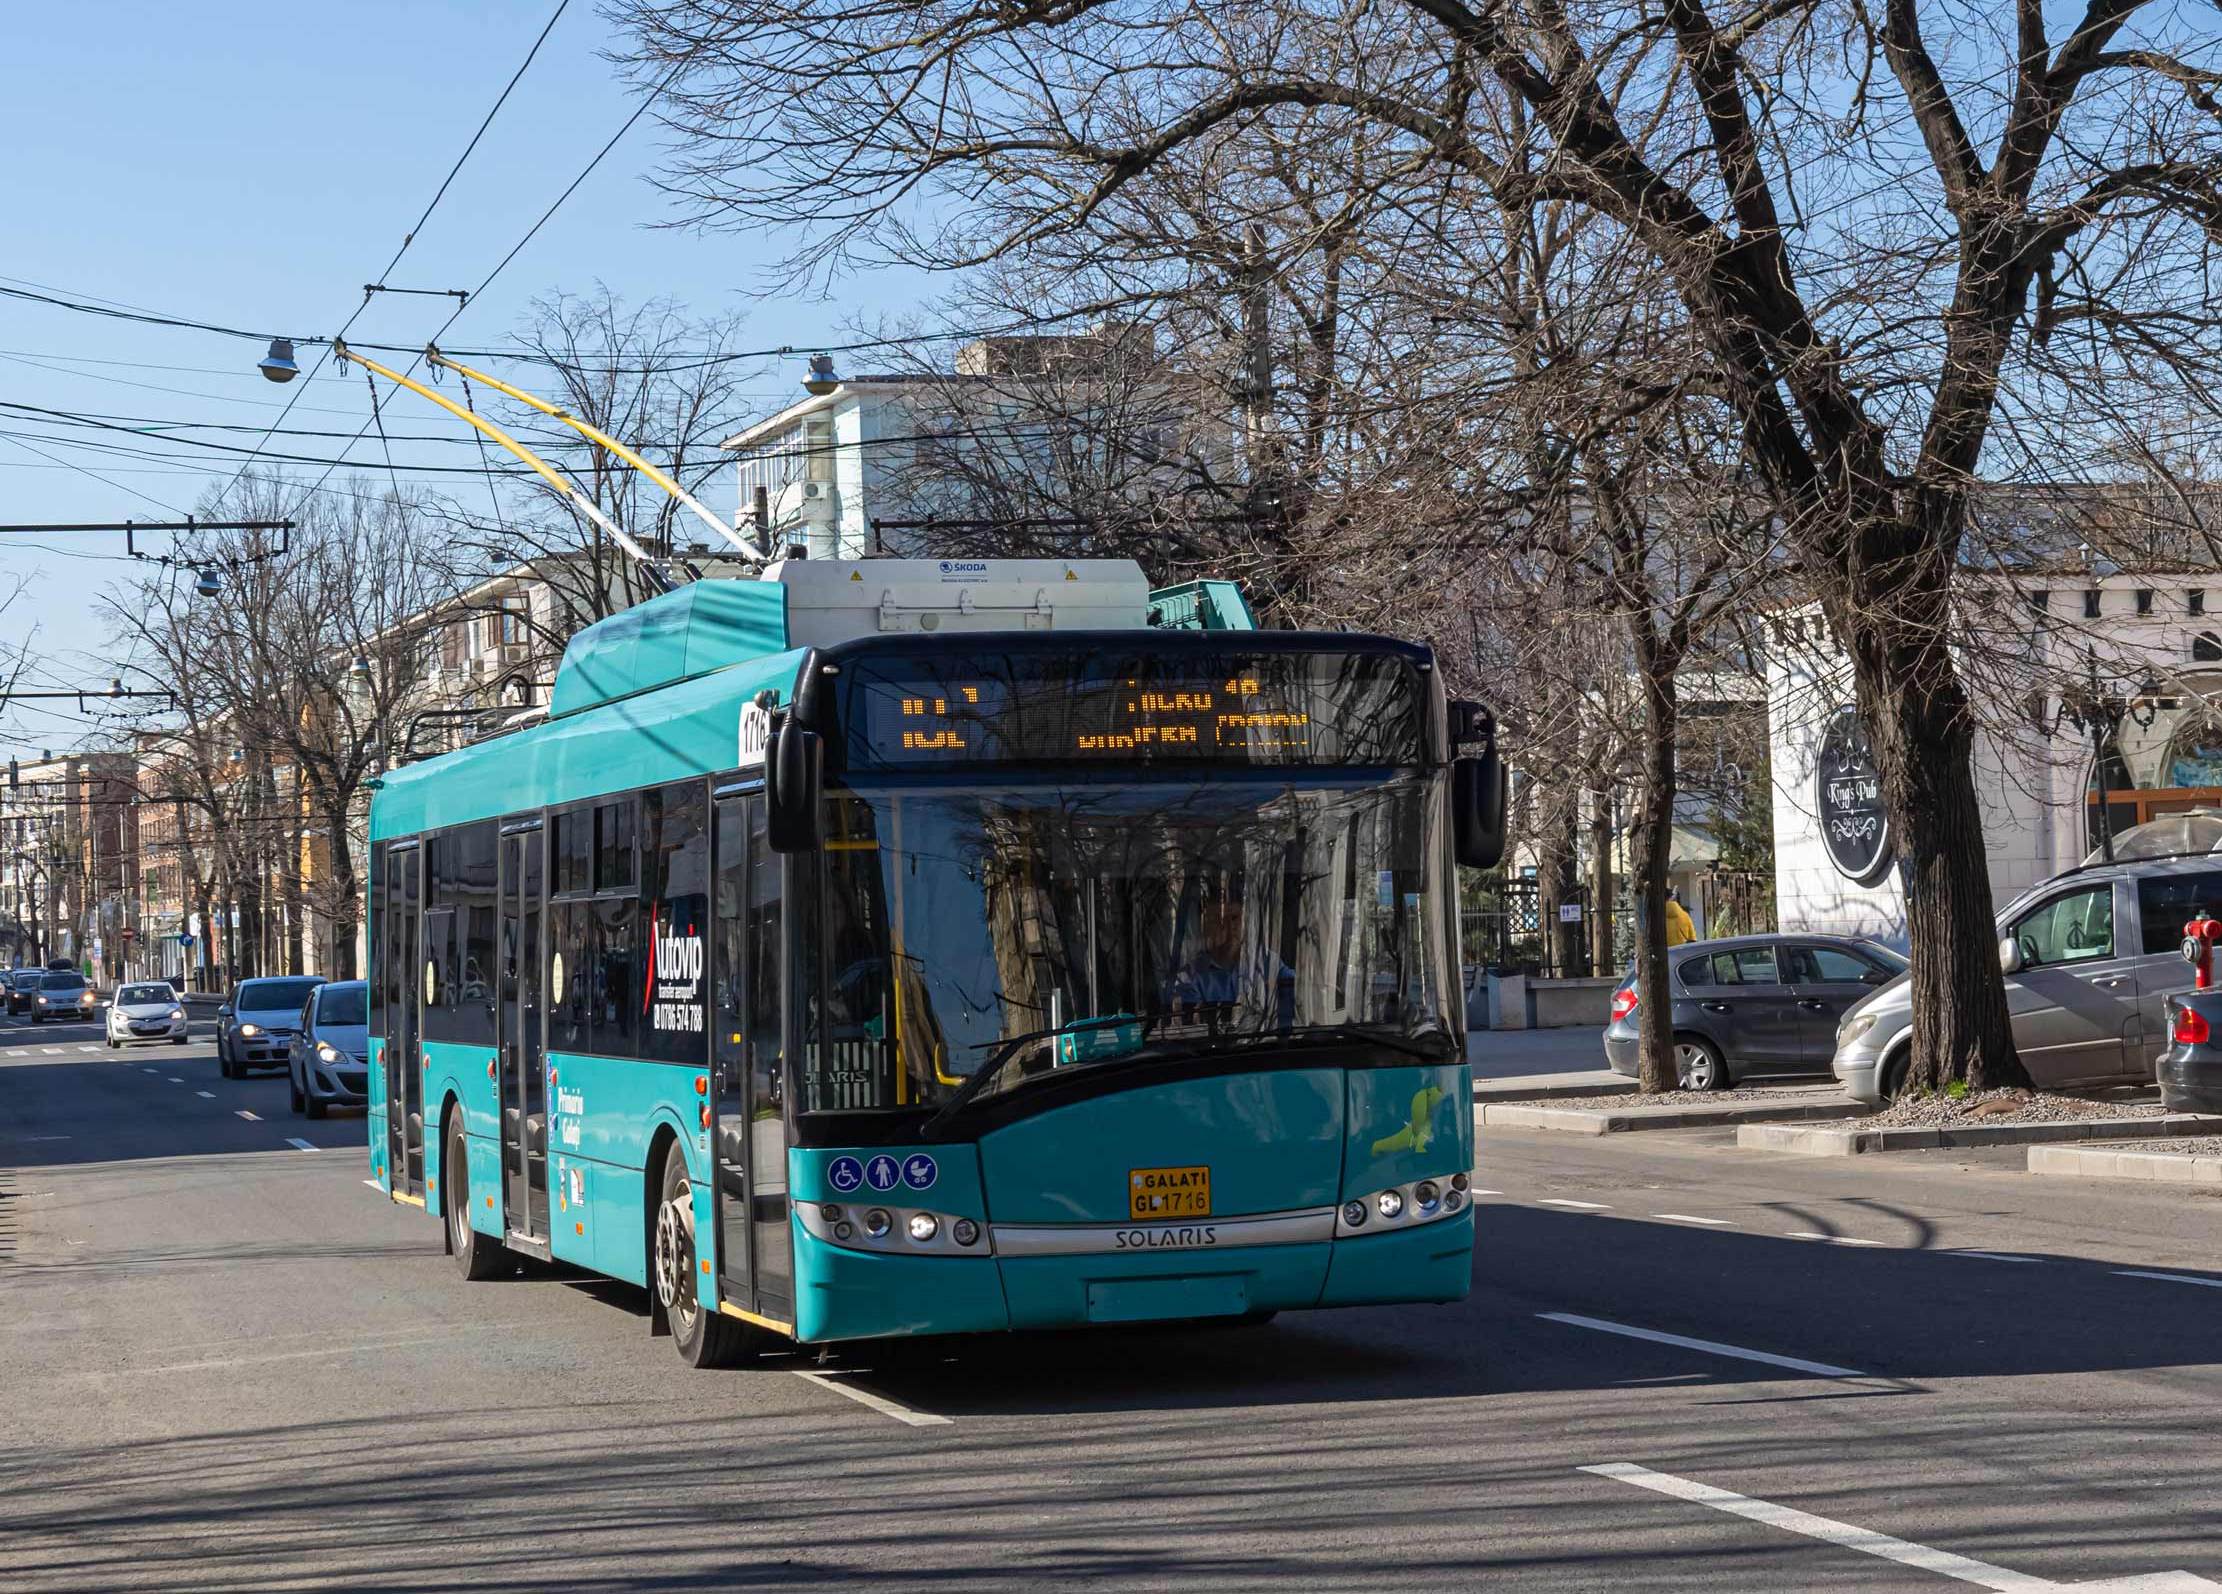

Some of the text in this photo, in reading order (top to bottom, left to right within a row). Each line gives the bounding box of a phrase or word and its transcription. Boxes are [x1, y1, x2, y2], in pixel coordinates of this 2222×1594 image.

[743, 709, 769, 755] 1716
[1827, 779, 1877, 809] King's Pub
[646, 908, 703, 995] Autovip
[661, 1003, 702, 1032] 0786 574 788
[1145, 1172, 1206, 1188] GALATI
[1115, 1227, 1216, 1249] SOLARIS
